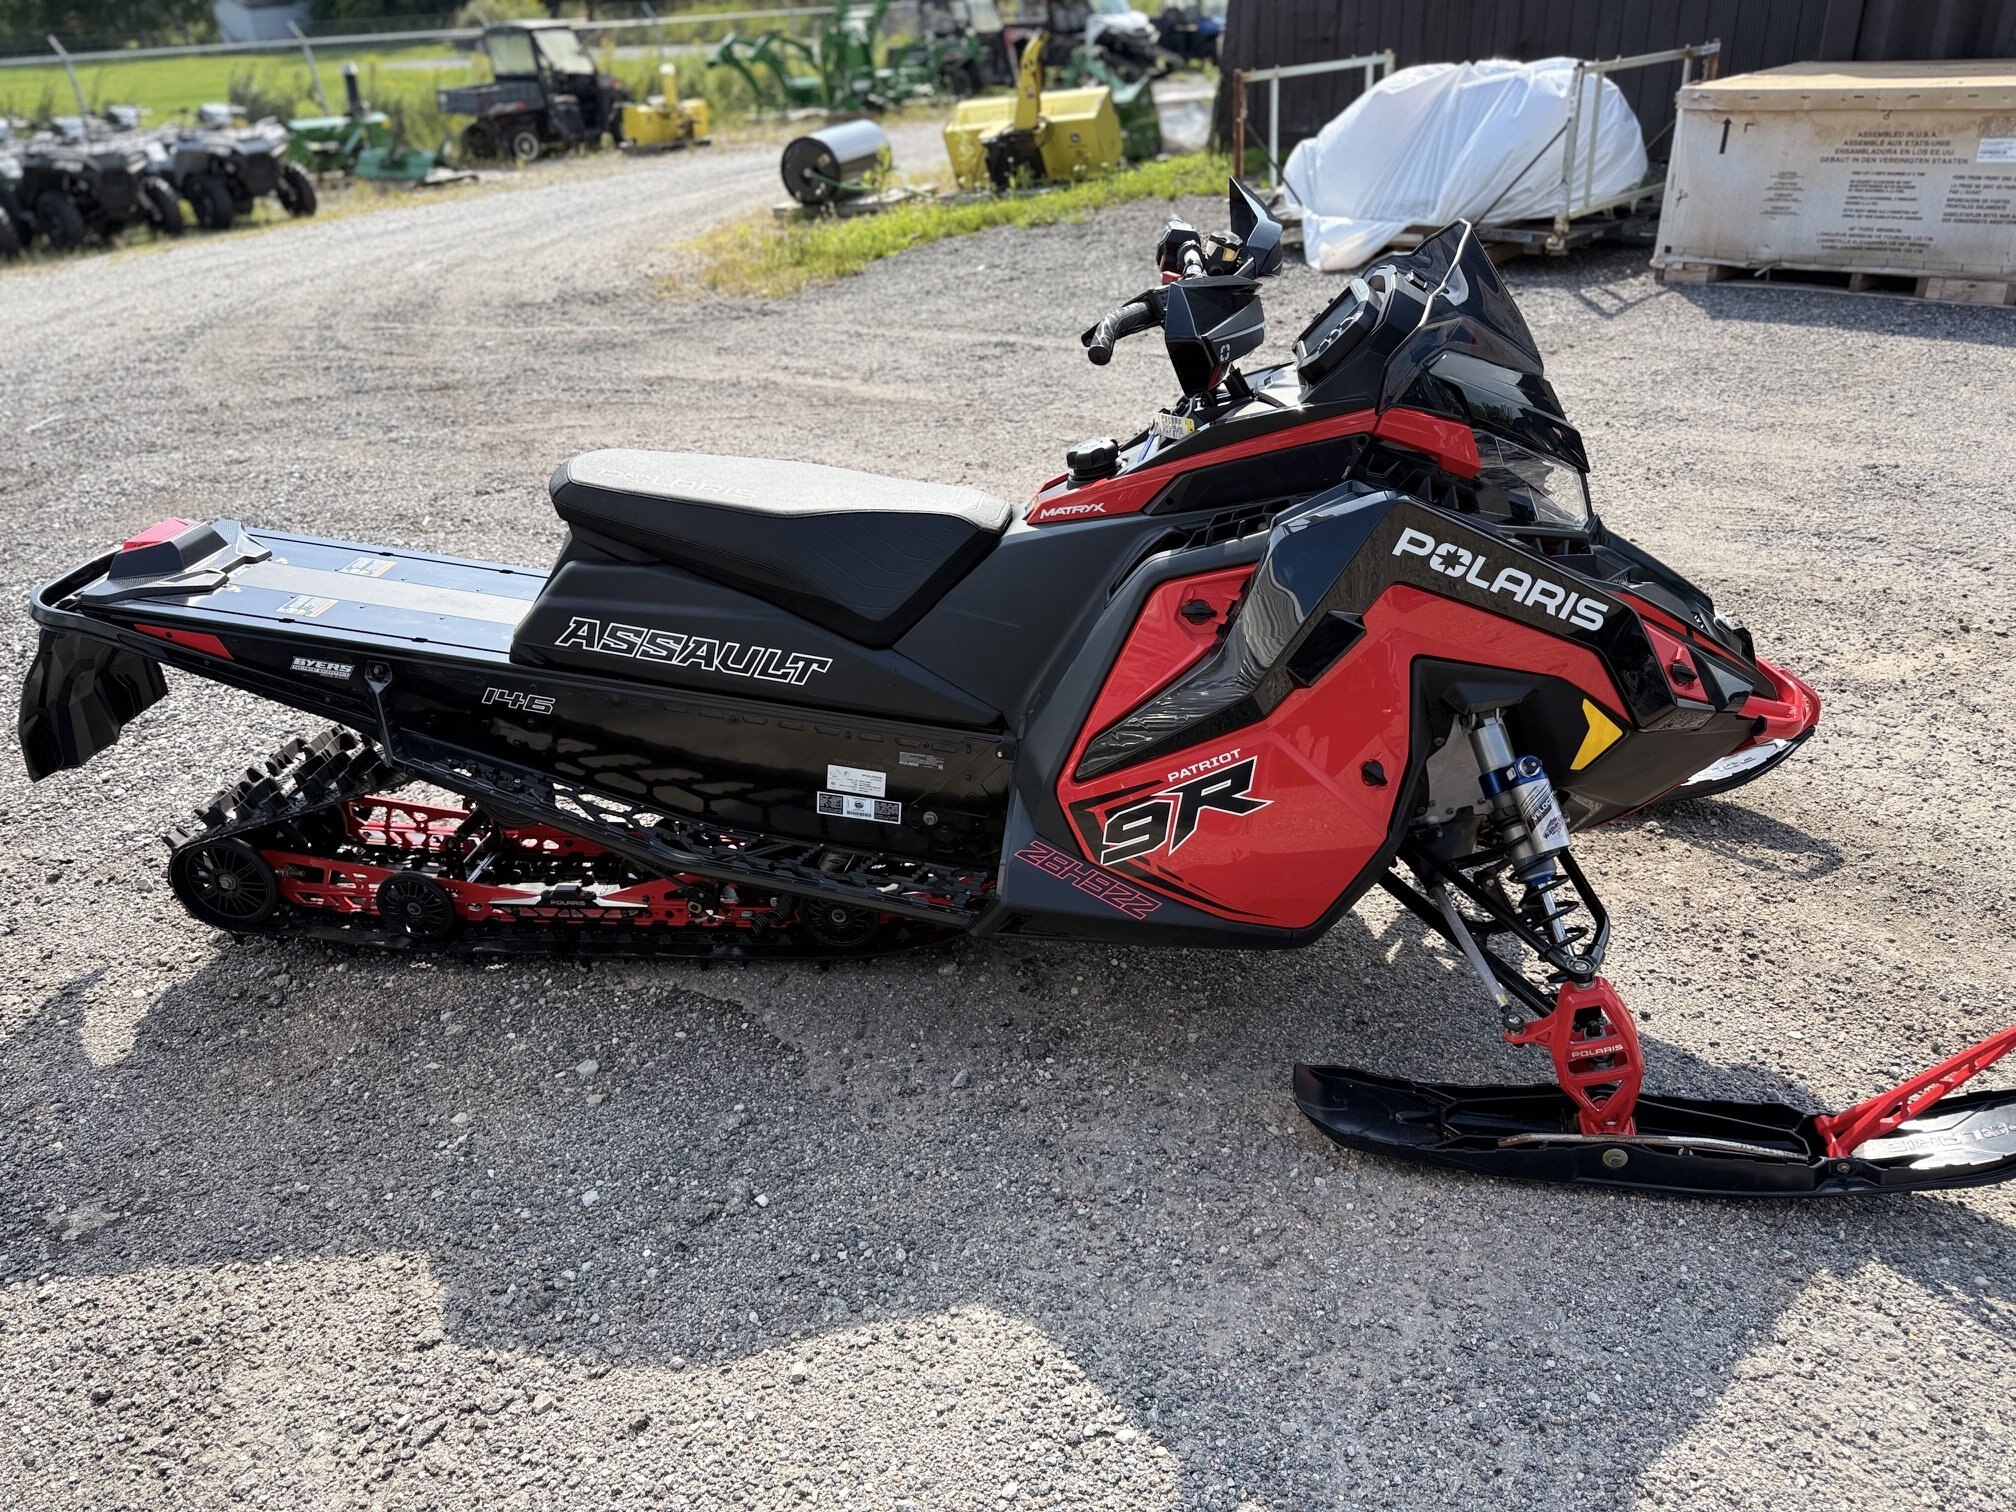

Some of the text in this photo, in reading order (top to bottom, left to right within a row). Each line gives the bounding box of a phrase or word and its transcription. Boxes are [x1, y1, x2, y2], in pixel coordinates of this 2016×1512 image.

[1040, 502, 1107, 519] MATRYX
[1391, 527, 1609, 631] POLARIS
[294, 657, 353, 673] BYERS
[554, 616, 834, 686] ASSAULT
[481, 687, 555, 714] 146
[1167, 748, 1242, 782] PATRIOT
[1101, 755, 1275, 866] 9R
[1571, 1044, 1624, 1058] POLARIS
